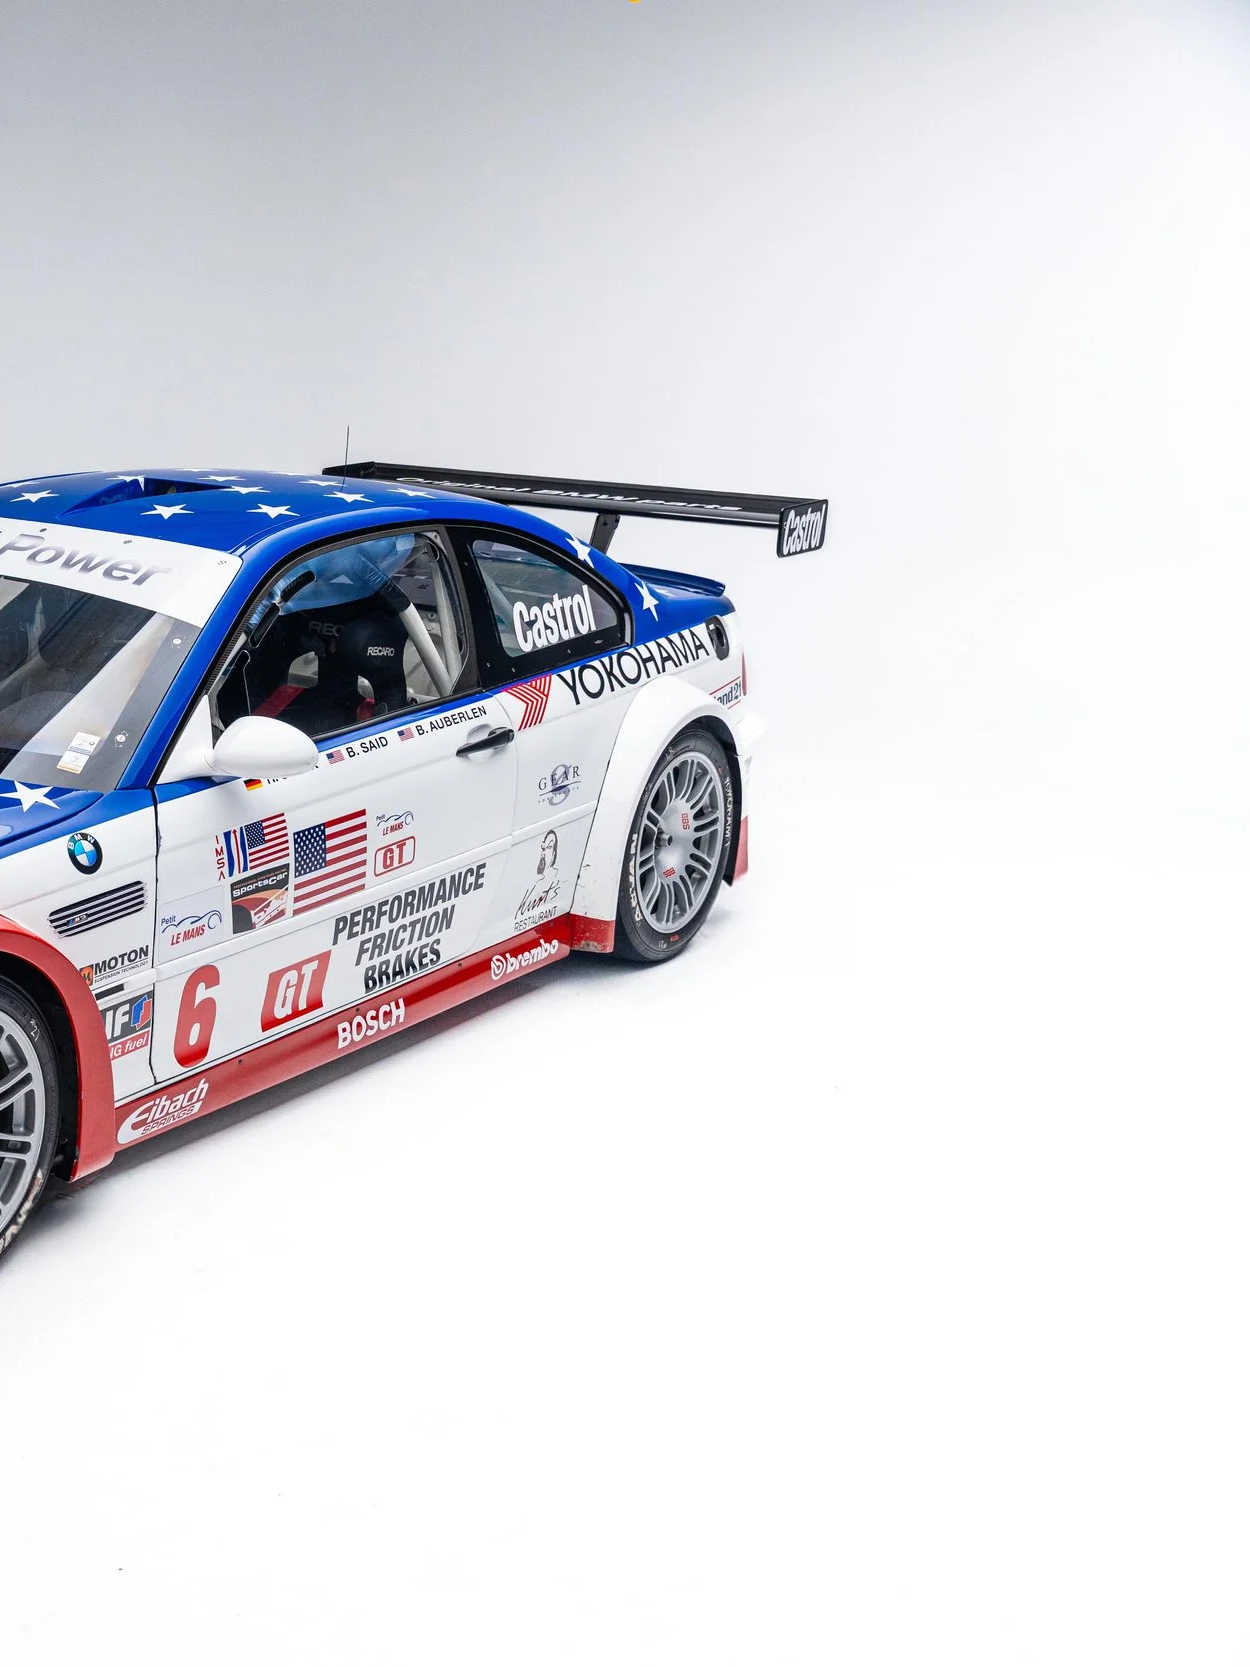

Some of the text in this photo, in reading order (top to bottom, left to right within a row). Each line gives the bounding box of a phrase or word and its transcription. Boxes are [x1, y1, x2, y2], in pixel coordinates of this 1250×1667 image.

[533, 490, 638, 501] BMW
[637, 499, 742, 511] parts
[782, 504, 826, 556] Castrol
[513, 585, 596, 652] Castrol
[367, 646, 395, 657] RECARO
[556, 628, 710, 706] YOKOHAMA
[415, 705, 487, 736] B. AUBERLEN
[346, 736, 389, 758] B. SAID
[383, 821, 404, 836] LE MANS
[681, 813, 691, 830] BBS
[67, 832, 95, 850] BMW
[383, 842, 406, 870] GT
[232, 871, 288, 897] SportsCar
[332, 862, 486, 946] PERFORMANCE
[514, 905, 558, 933] RESTAURANT
[161, 914, 176, 926] Petit
[171, 924, 206, 946] LE MANS
[355, 904, 456, 967] FRICTION
[94, 945, 150, 975] MOTON
[94, 960, 149, 984] SUSPENSION TECHNOLOGY
[364, 939, 441, 994] BRAKES
[505, 939, 559, 975] brembo
[274, 960, 319, 1019] GT
[173, 964, 221, 1068] 6
[337, 998, 405, 1049] BOSCH
[124, 1034, 148, 1053] fuel
[117, 1078, 209, 1145] Eibach
[140, 1104, 195, 1135] SPRINGS
